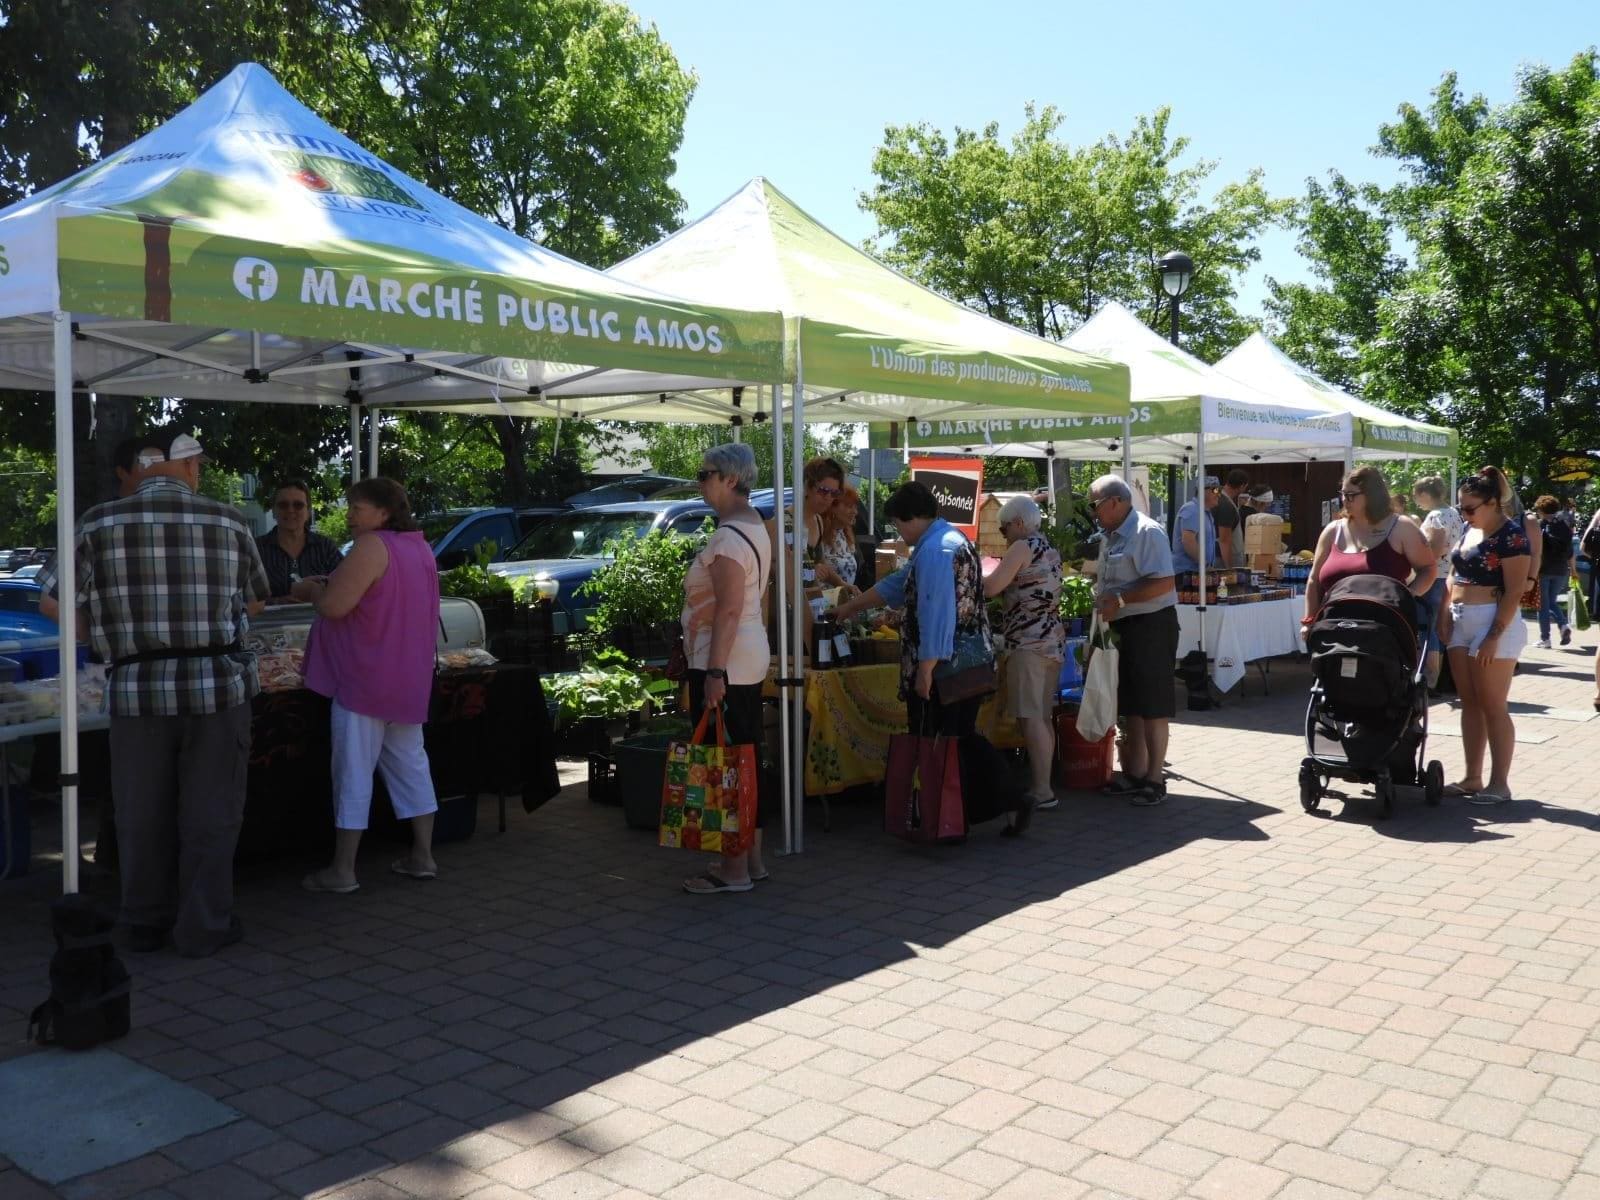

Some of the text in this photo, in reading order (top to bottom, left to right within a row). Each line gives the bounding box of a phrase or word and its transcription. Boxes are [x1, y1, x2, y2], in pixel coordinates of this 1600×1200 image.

[301, 267, 723, 354] MARCHÉ PUBLIC AMOS
[870, 345, 1093, 393] L'Union des producteurs agricoles
[1018, 416, 1083, 431] PUBLIC
[1217, 402, 1257, 423] Bienvenue
